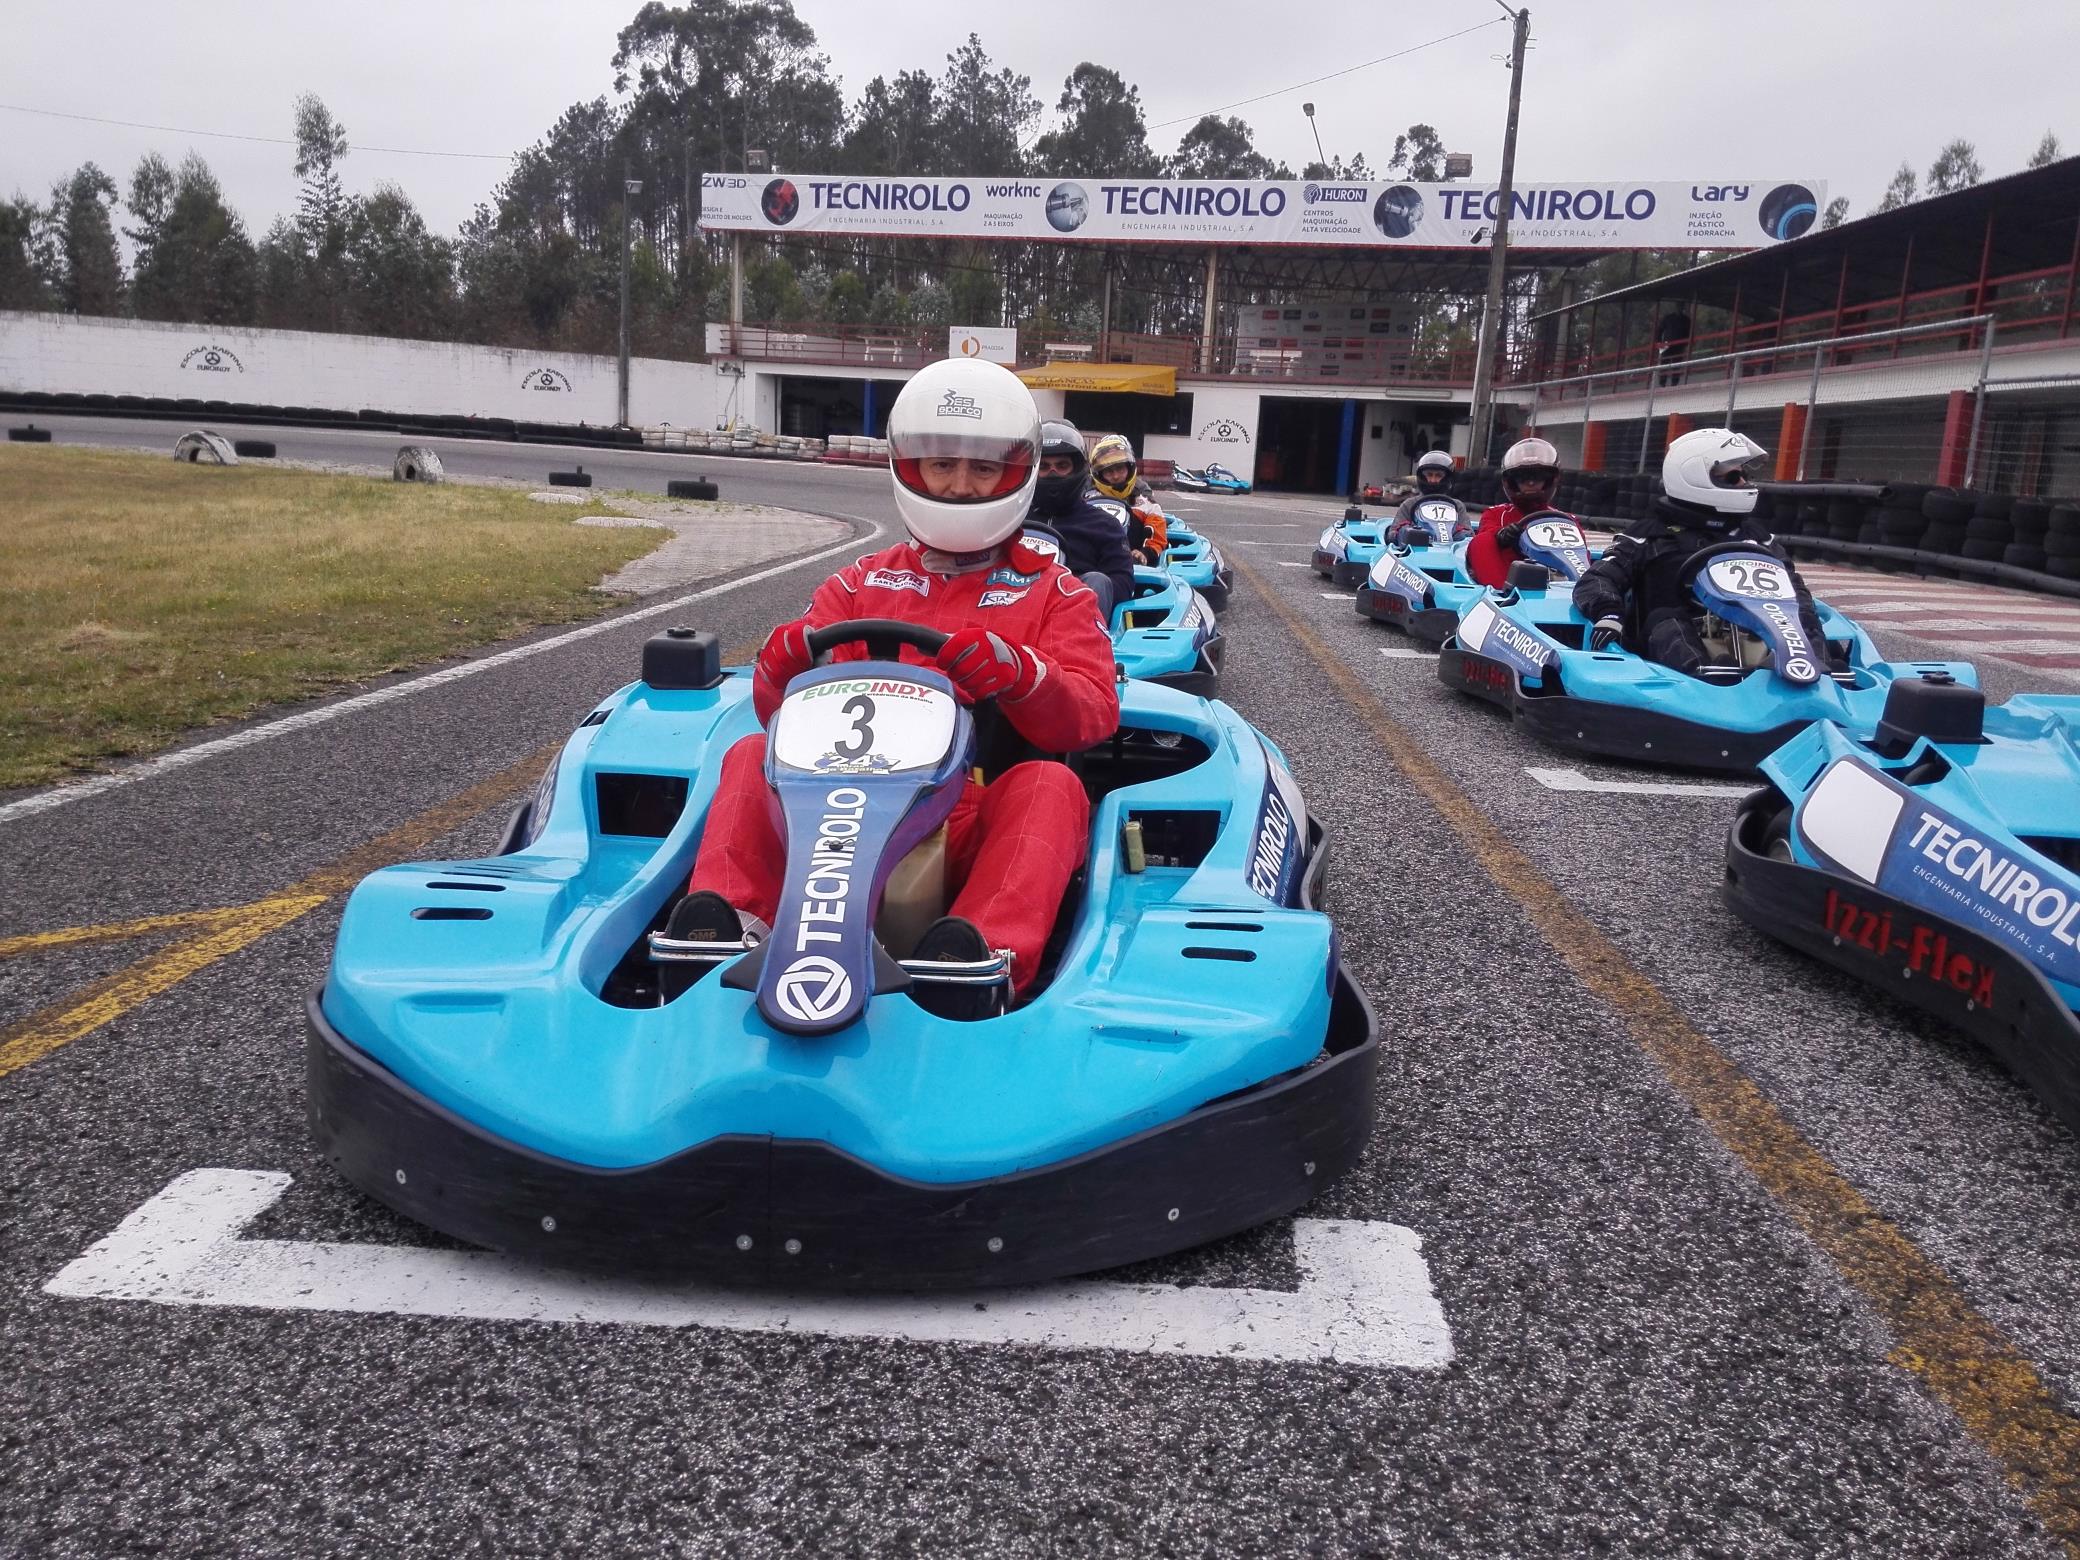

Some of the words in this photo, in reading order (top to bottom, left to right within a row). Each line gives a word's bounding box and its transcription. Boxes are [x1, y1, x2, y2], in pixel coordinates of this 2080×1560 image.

[808, 182, 971, 212] TECNIROLO
[985, 181, 1042, 198] worknc
[1324, 188, 1365, 201] HURON
[1101, 186, 1287, 217] TECNIROLO
[829, 216, 877, 224] ENGENHARIA
[1303, 209, 1334, 217] CENTROS
[1689, 211, 1722, 219] INJEÇÃO
[1121, 222, 1177, 231] ENGENHARIA
[1180, 224, 1237, 233] INDUSTRIAL,
[1302, 218, 1348, 226] MAQUINAÇÃO
[1320, 226, 1361, 234] VELOCIDADE
[1530, 229, 1597, 238] INDUSTRIAL,
[180, 345, 208, 369] ESCOLA
[212, 345, 244, 374] KARTING
[1198, 419, 1221, 441] ESCOLA
[1225, 418, 1251, 444] KARTING
[1431, 506, 1446, 519] 17
[1542, 526, 1580, 544] 25
[1722, 560, 1780, 572] EUROINDY
[1393, 563, 1428, 595] TECNIROL
[1729, 565, 1780, 592] 26
[801, 681, 935, 701] EUROINDY
[834, 694, 876, 761] 3
[1252, 793, 1289, 898] ECNIROLO
[796, 787, 867, 952] TECNIROLO
[1912, 864, 1972, 907] ENGENHARIA
[1972, 901, 2033, 950] INDUSTRIAL,
[688, 929, 717, 941] OMP
